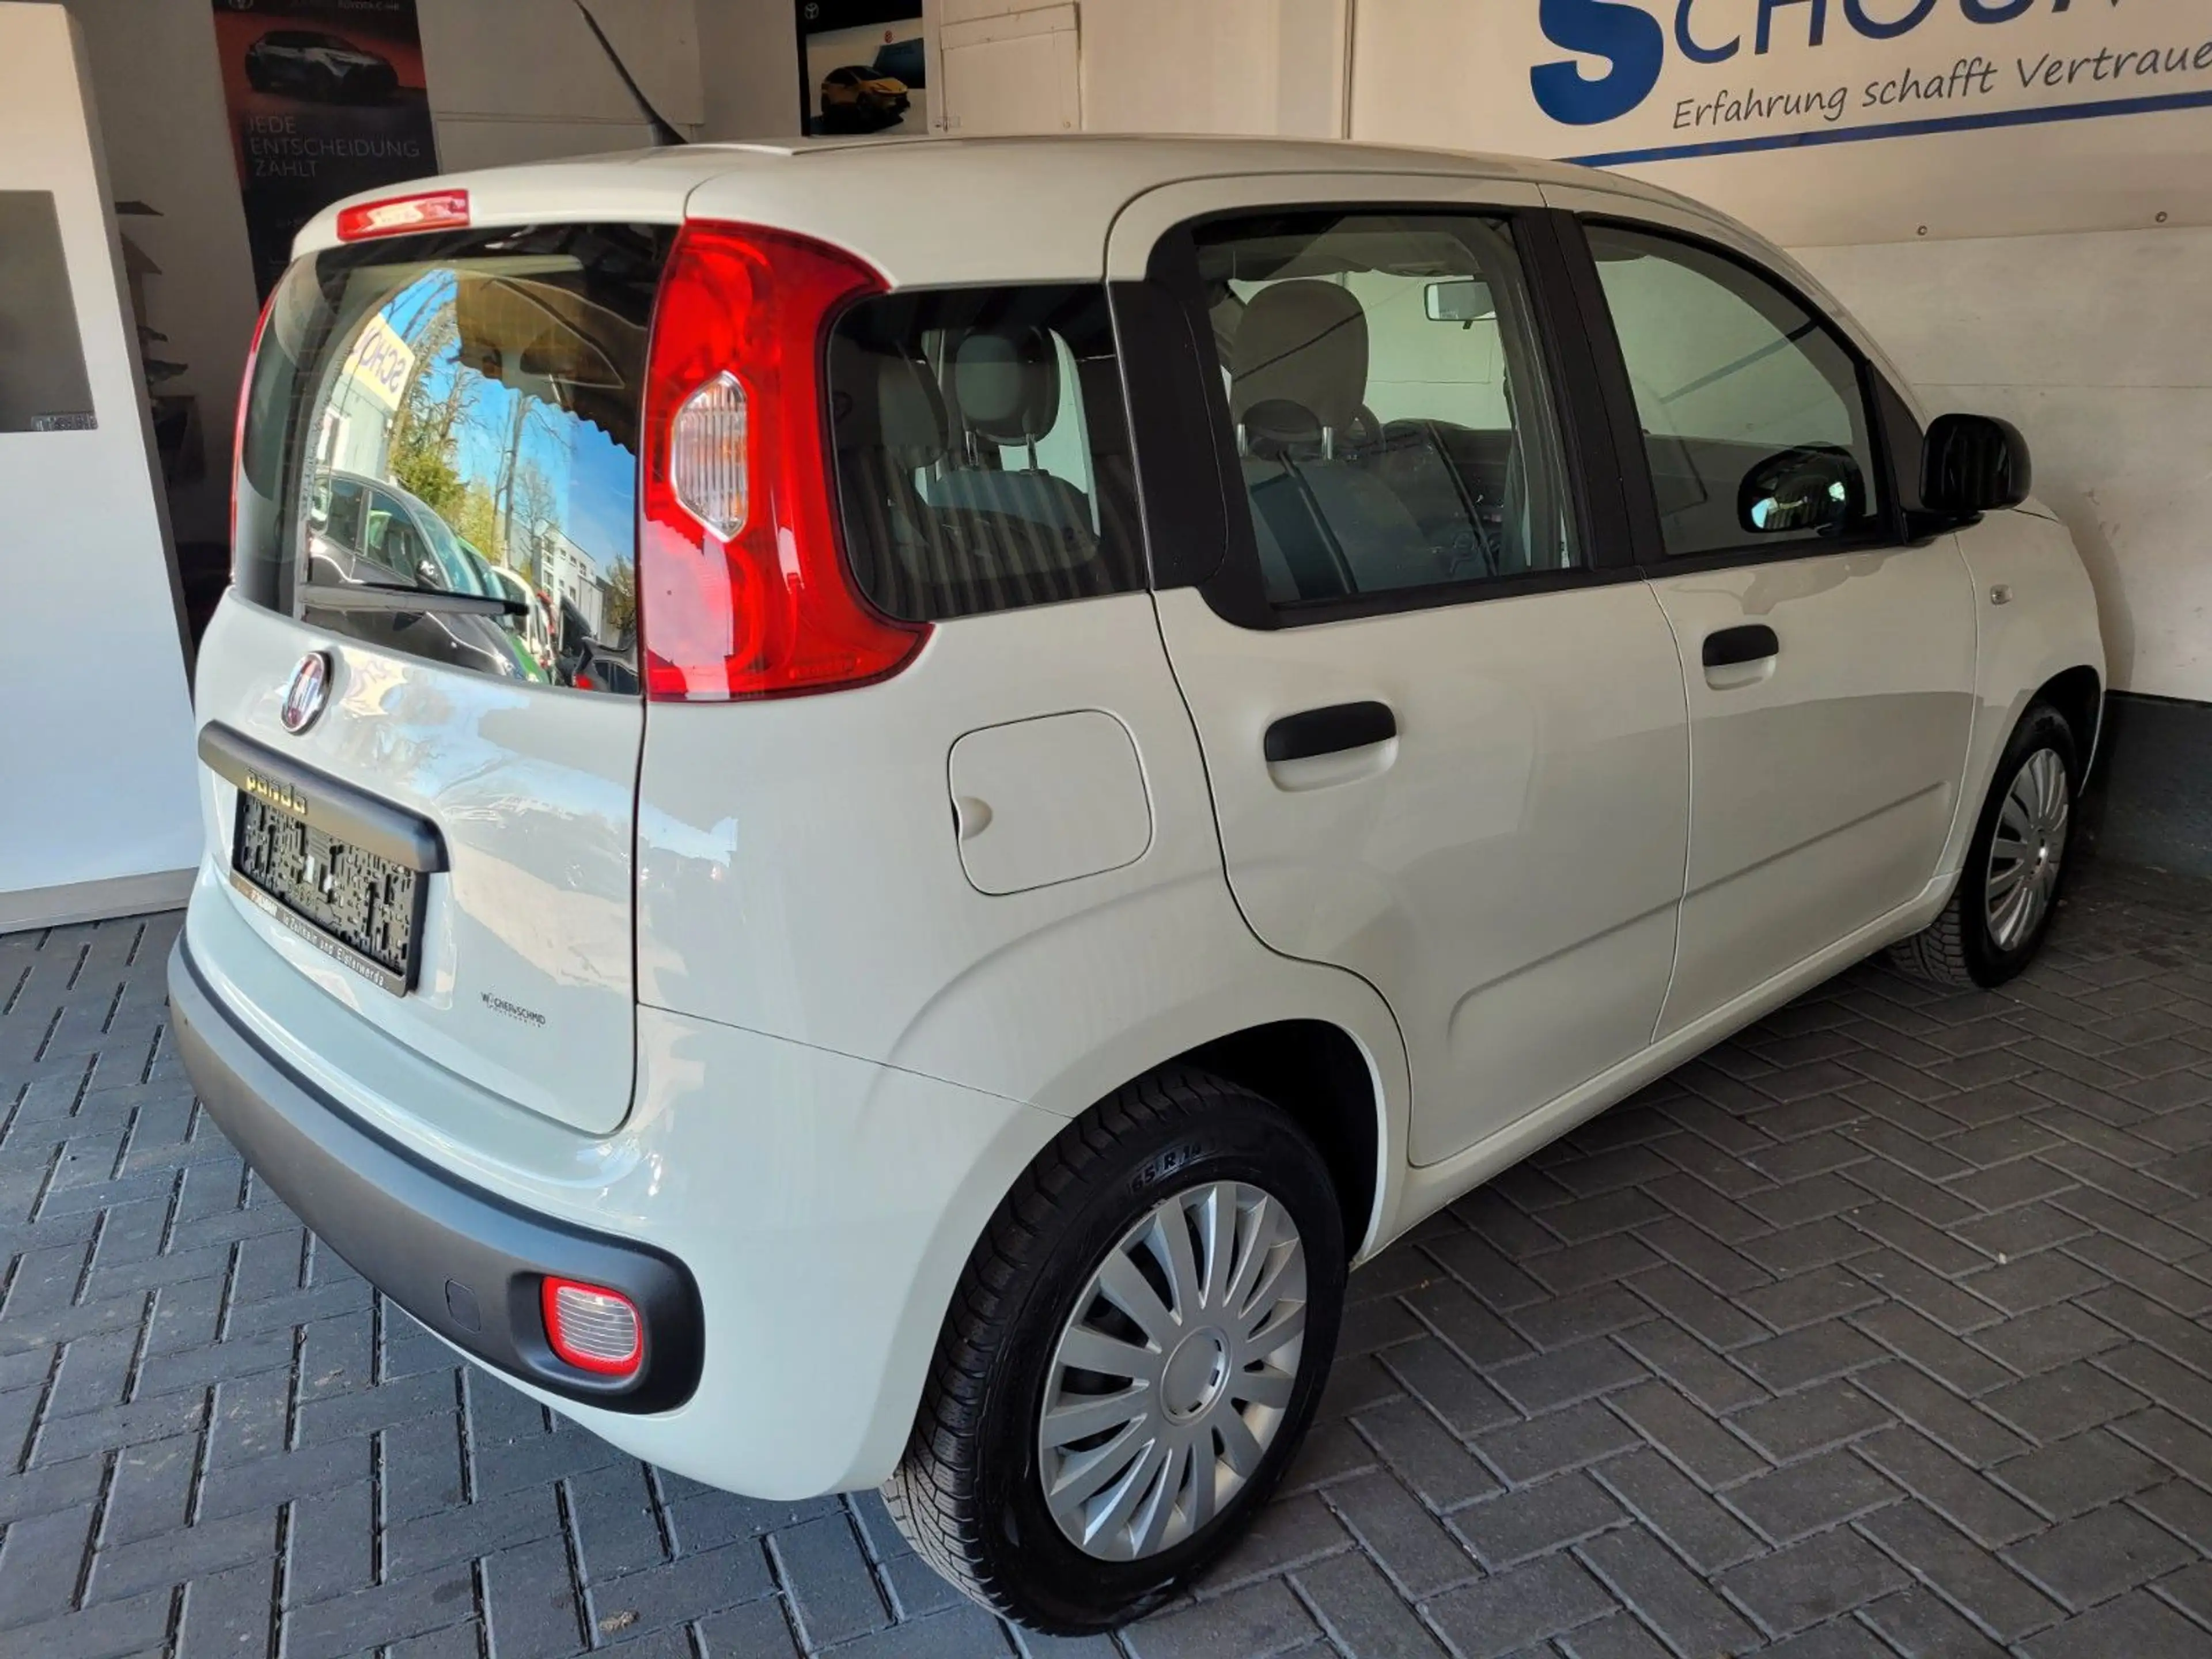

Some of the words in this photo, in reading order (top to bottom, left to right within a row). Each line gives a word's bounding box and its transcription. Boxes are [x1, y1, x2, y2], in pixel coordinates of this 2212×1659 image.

[1530, 0, 2120, 126] SCH
[1673, 86, 1848, 129] Erfahrung
[1861, 56, 1998, 107] schafft
[2016, 41, 2212, 88] Vertraue
[249, 115, 297, 134] JEDE
[250, 137, 421, 157] ENTSCHEIDUNG
